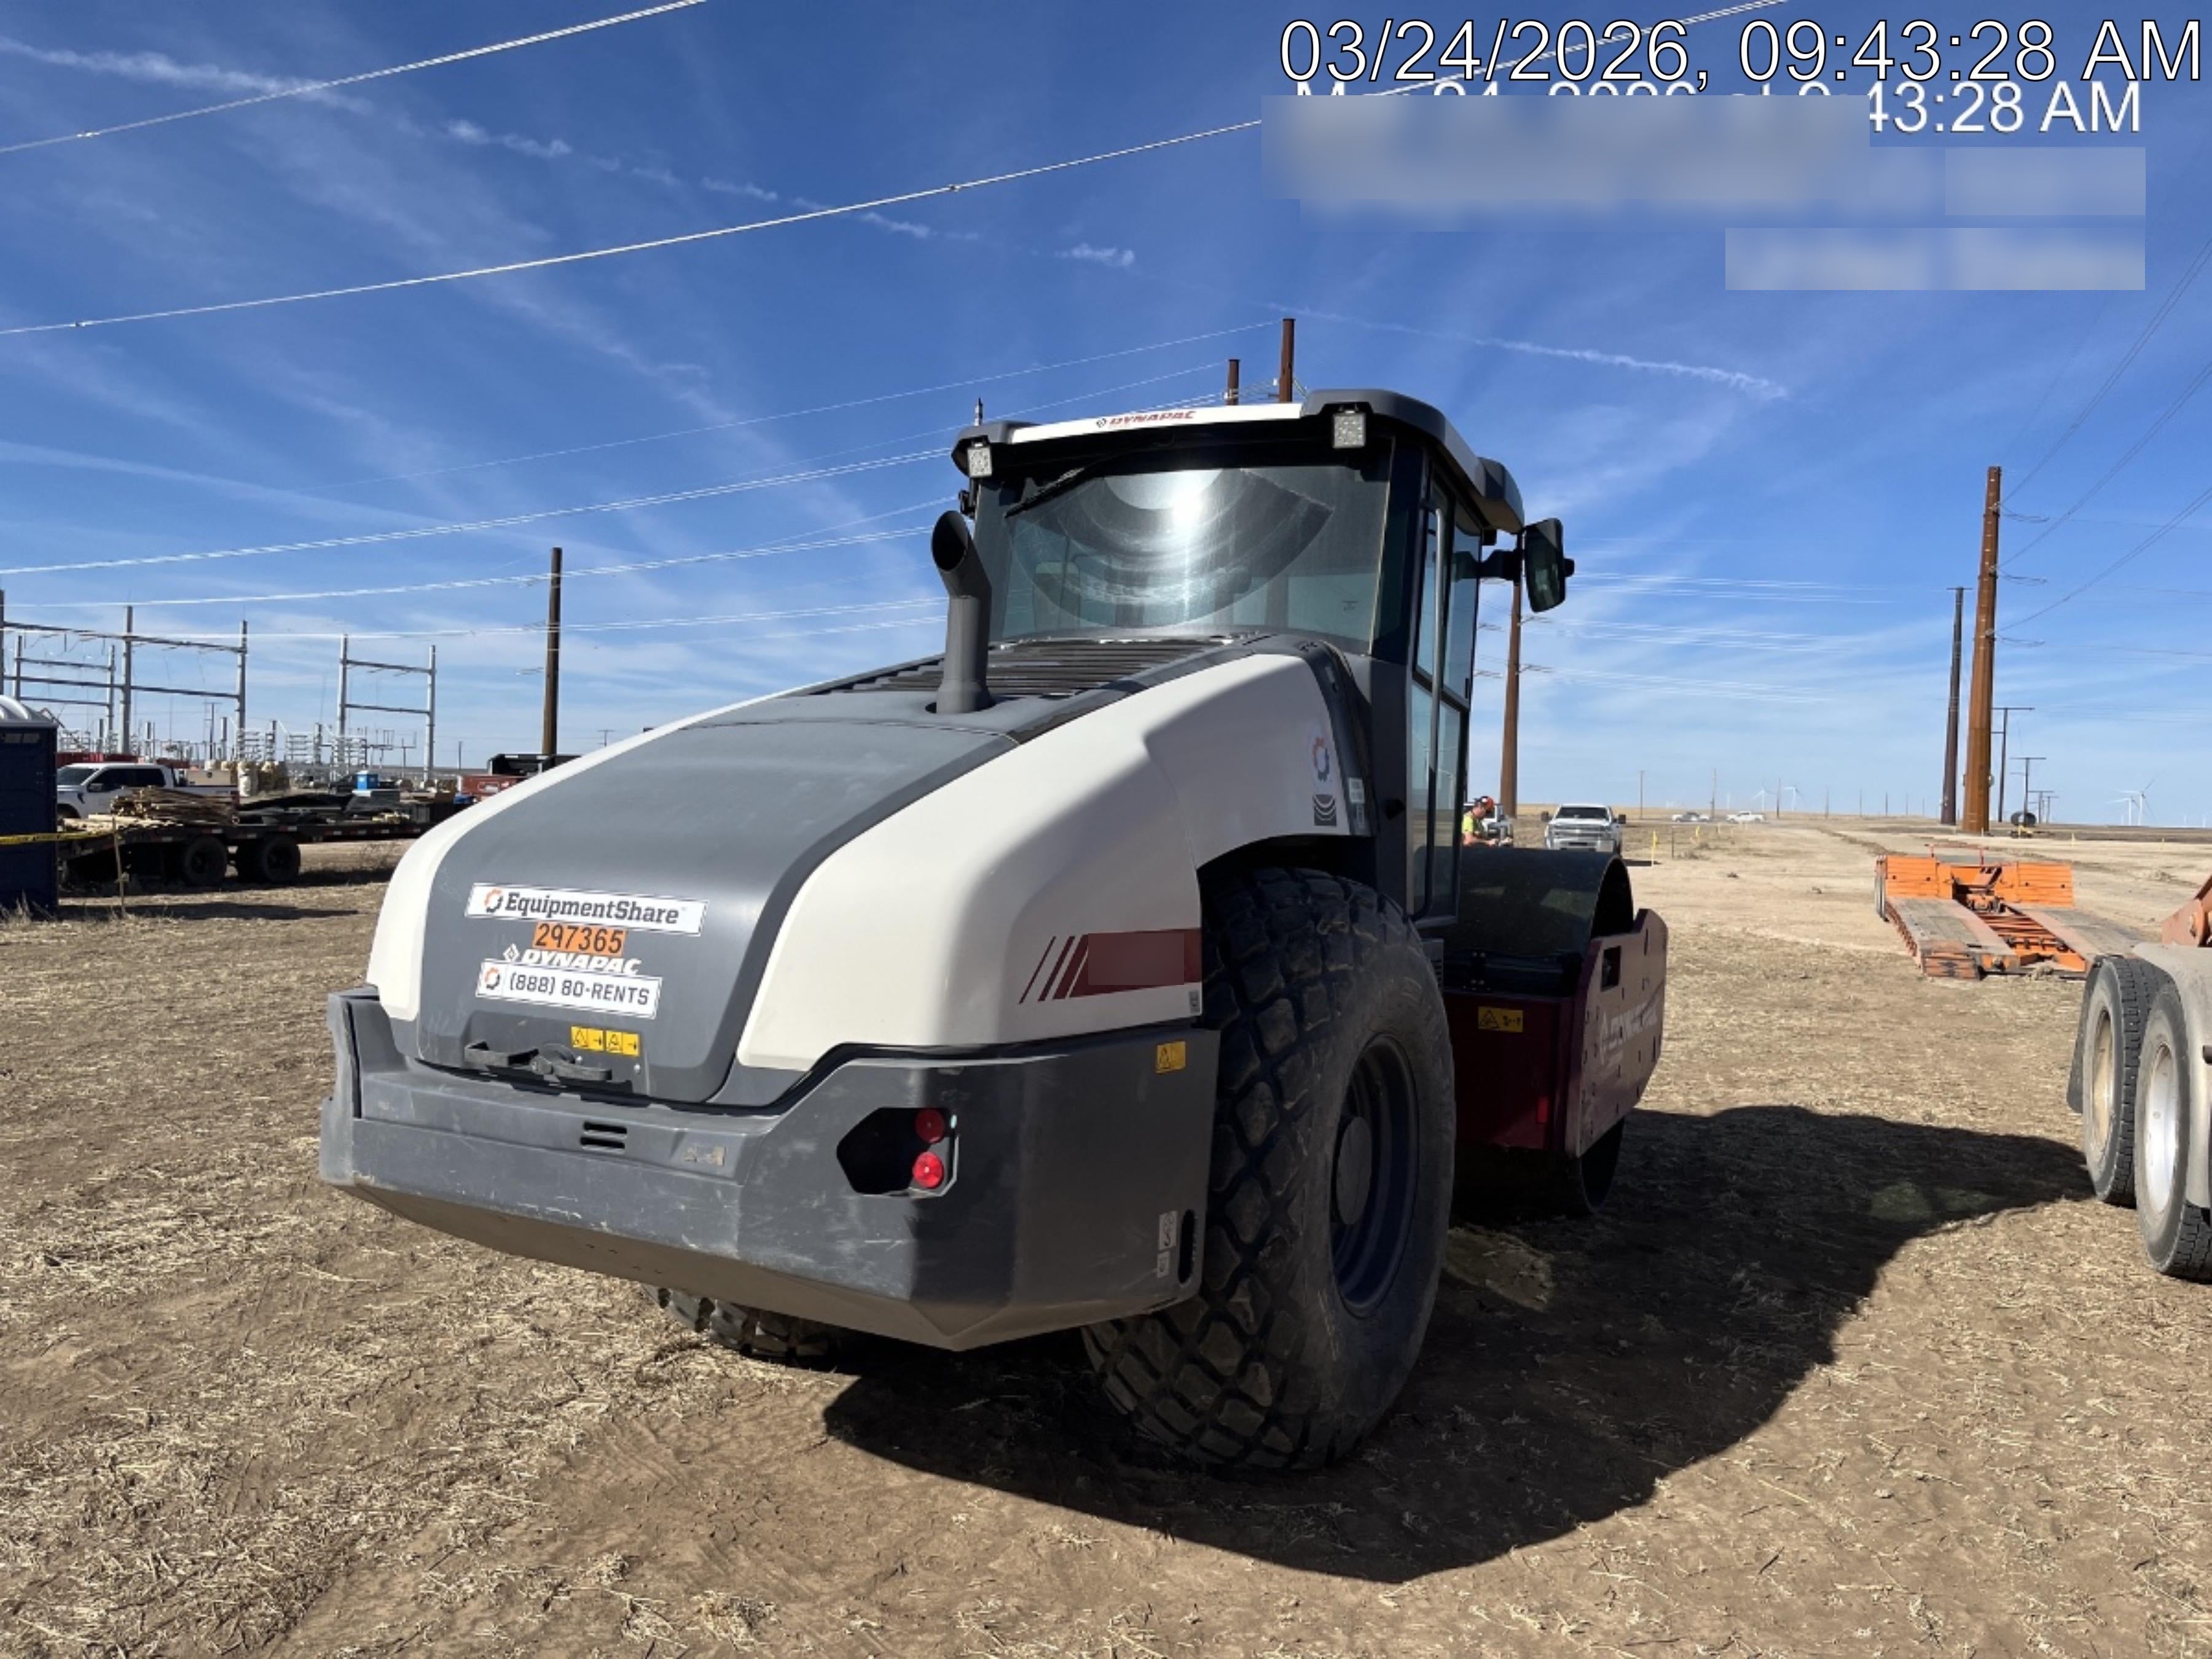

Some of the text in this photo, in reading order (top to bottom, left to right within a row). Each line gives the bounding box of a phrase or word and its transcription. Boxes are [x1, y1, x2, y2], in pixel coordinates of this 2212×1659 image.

[505, 893, 679, 924] EquipmentShare
[535, 923, 623, 954] 297365
[522, 949, 641, 975] DYNAPAC
[510, 973, 649, 1005] (888) 80-RENTS
